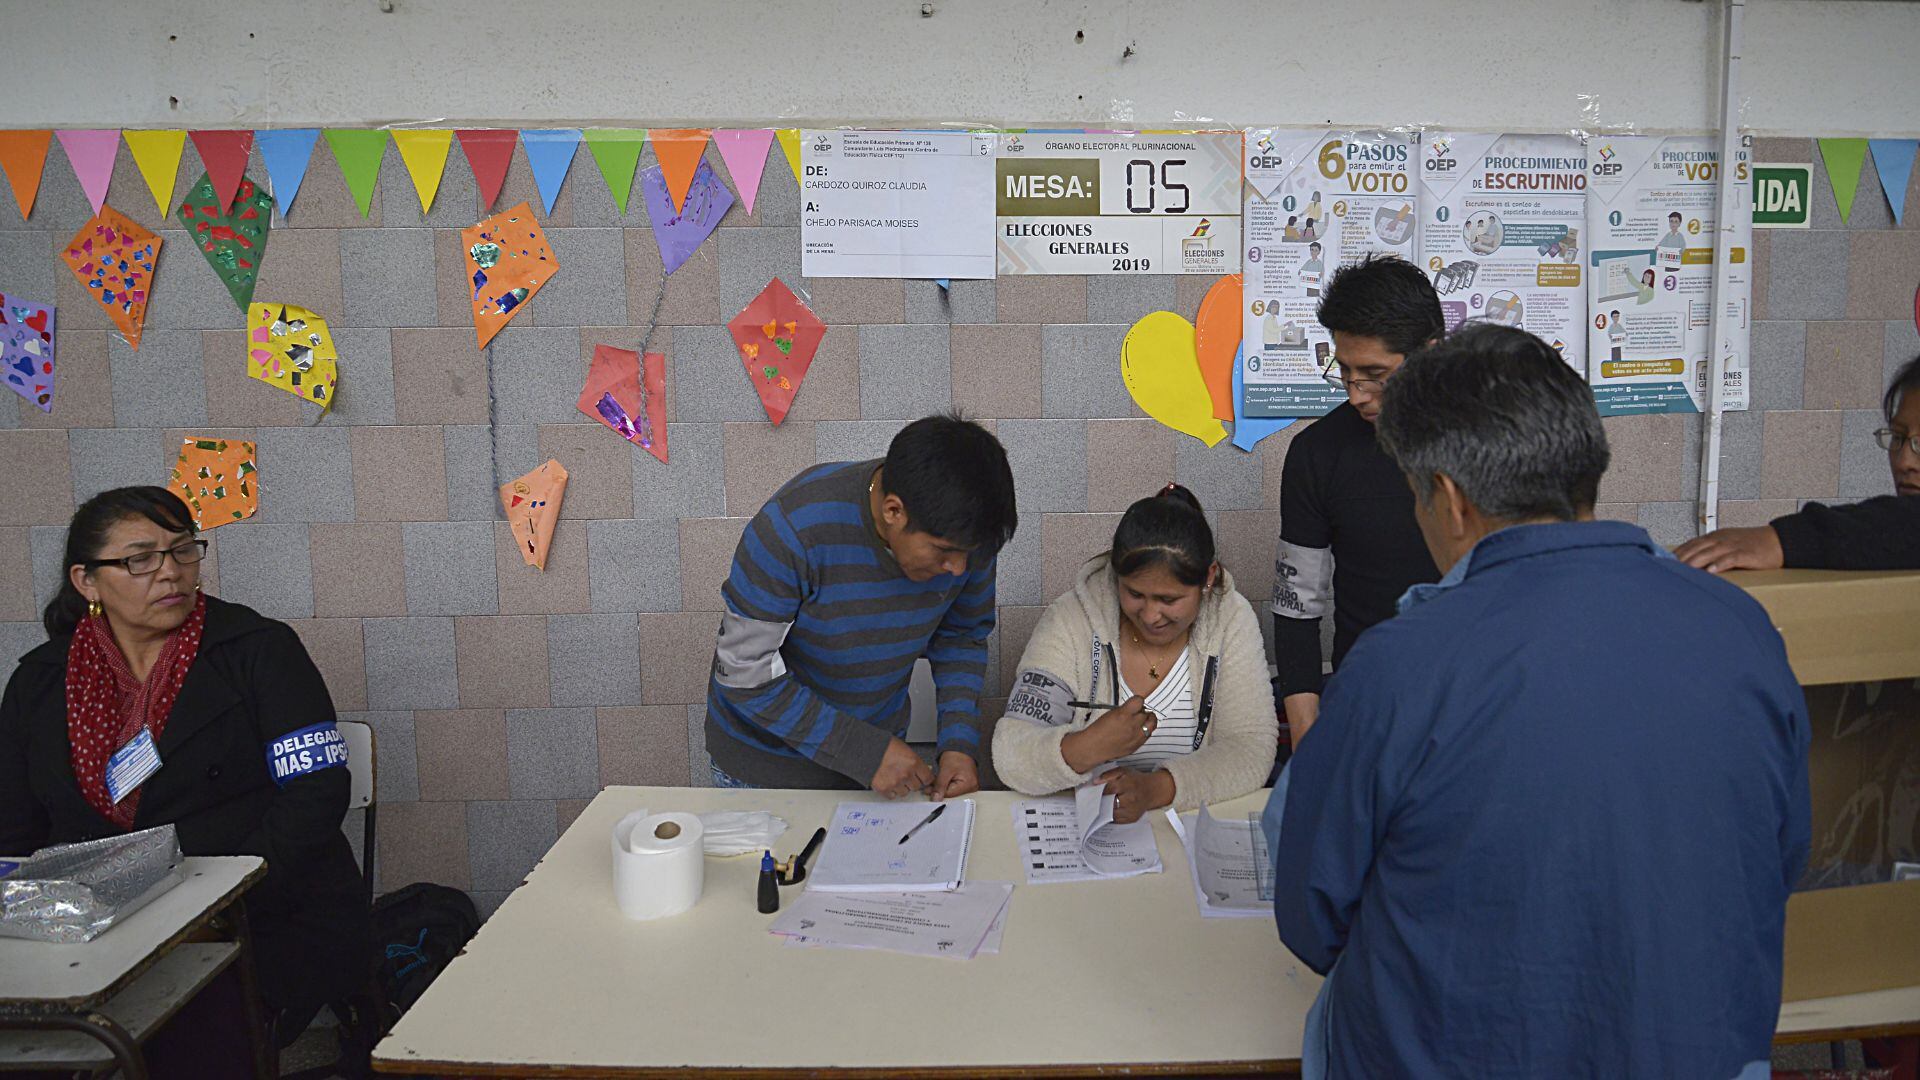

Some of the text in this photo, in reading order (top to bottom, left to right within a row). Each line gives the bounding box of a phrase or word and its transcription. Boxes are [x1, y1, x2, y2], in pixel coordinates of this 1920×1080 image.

[814, 144, 832, 152] OEP
[1046, 141, 1196, 151] ÓRGANO ELECTORAL PLURINACIONAL
[1250, 157, 1282, 169] OEP
[1318, 140, 1408, 180] 6 PASOS
[1426, 159, 1457, 171] OEP
[1485, 157, 1587, 170] PROCEDIMIENTO
[806, 166, 828, 176] DE:
[1349, 163, 1406, 171] para emitir el
[1592, 164, 1623, 176] OEP
[1685, 162, 1748, 181] VOTS
[806, 181, 927, 191] CARDOZO QUIROZ CLAUDIA
[1006, 175, 1092, 198] MESA:
[1126, 160, 1190, 214] 05
[1347, 173, 1408, 193] VOTO
[1473, 173, 1587, 190] DE ESCRUTINIO
[1753, 179, 1801, 212] IDA
[806, 202, 819, 212] A:
[1336, 202, 1345, 216] 2
[806, 219, 919, 228] CHEJO PARISACA MOISES
[1006, 224, 1092, 237] ELECCIONES
[1049, 242, 1129, 255] GENERALES
[1184, 250, 1225, 258] ELECCIONES
[1112, 258, 1150, 271] 2019
[1273, 596, 1306, 613] TORAL
[1022, 672, 1056, 688] OEP
[1012, 694, 1051, 711] JURADO
[274, 751, 313, 778] MAS
